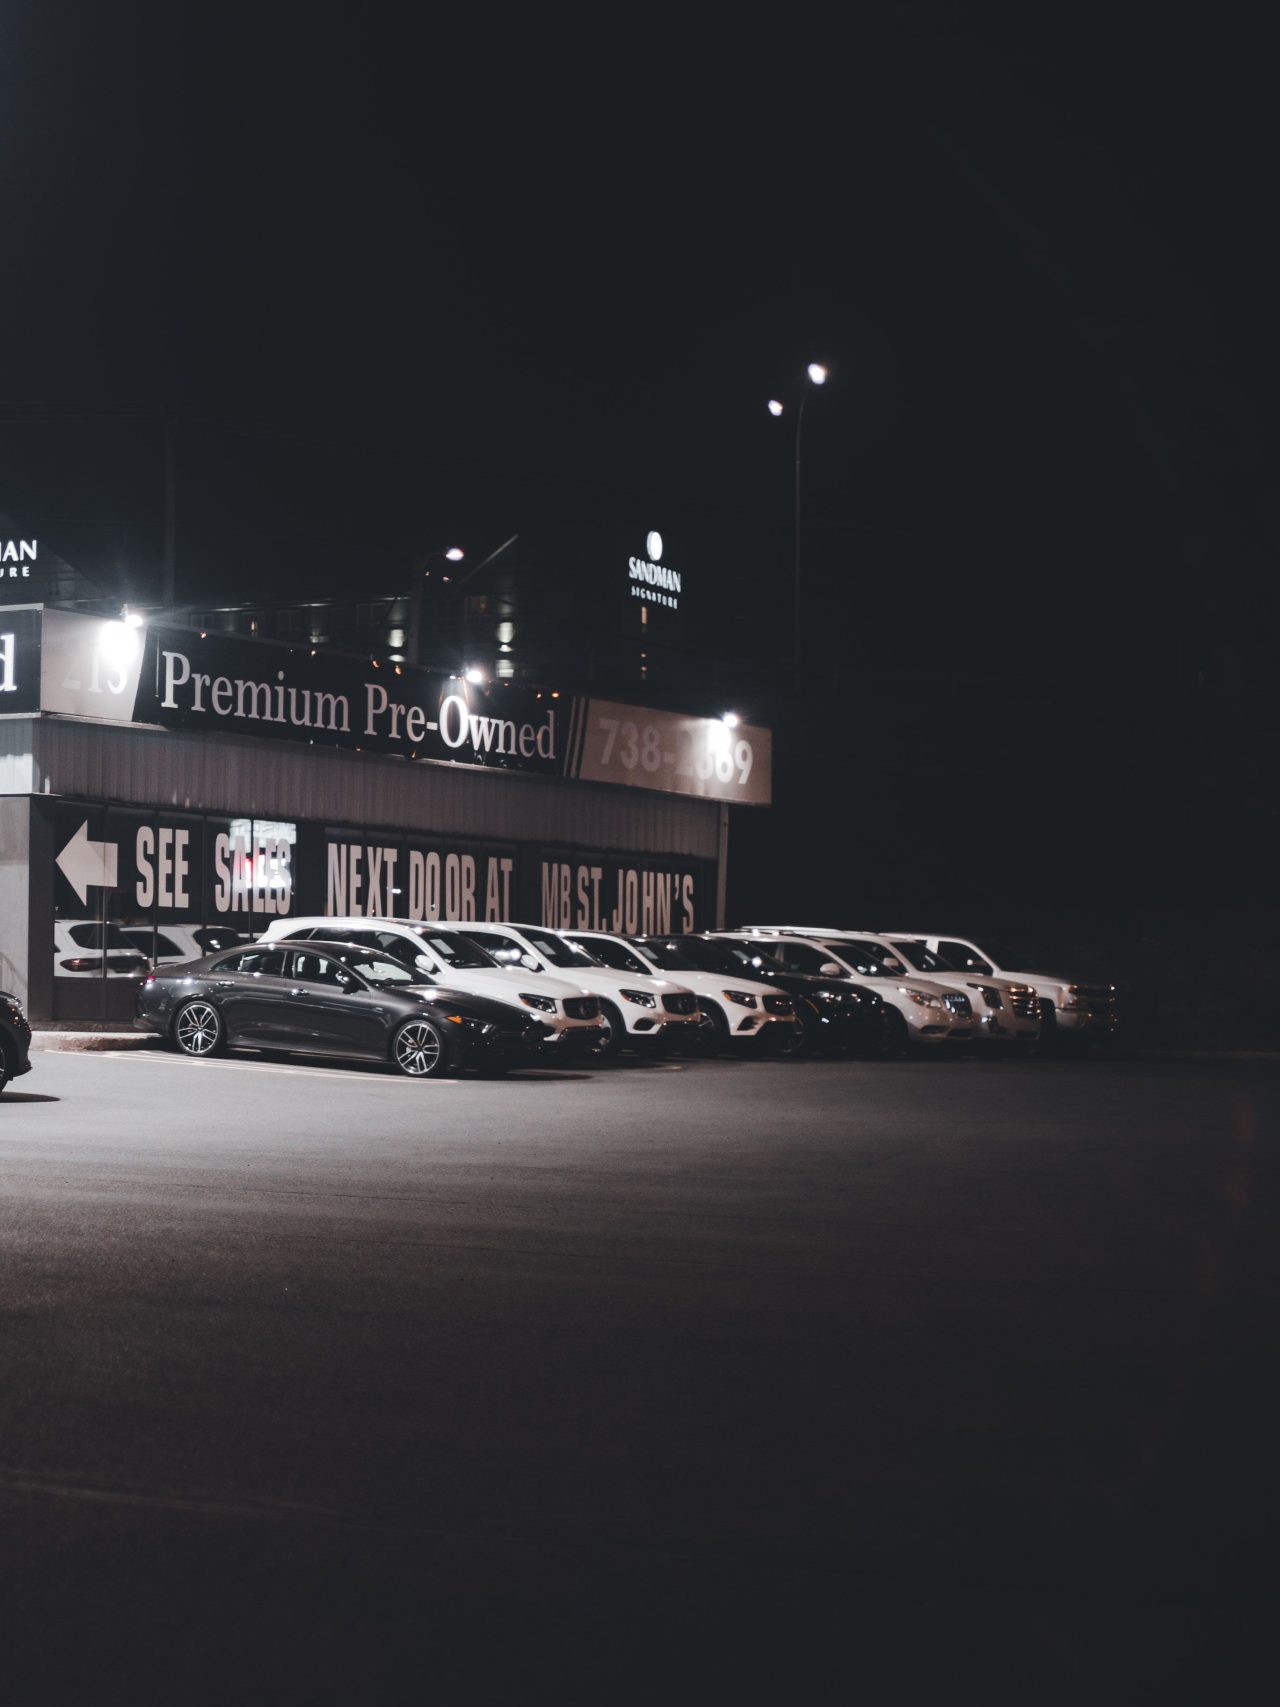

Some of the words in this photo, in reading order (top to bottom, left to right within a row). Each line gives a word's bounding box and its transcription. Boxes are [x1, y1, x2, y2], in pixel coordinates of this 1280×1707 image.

[628, 556, 681, 593] SANDMAN
[631, 586, 678, 609] SIGNATURE
[161, 651, 351, 732] Premium
[364, 683, 556, 759] Pre-Owned
[136, 826, 189, 908] SEE
[215, 833, 291, 915] SALES
[327, 842, 398, 917] NEXT
[409, 850, 477, 922] DOOR
[485, 857, 513, 923] AT
[542, 862, 570, 930] MB
[577, 865, 607, 931] ST.
[613, 869, 694, 935] JOHN'S
